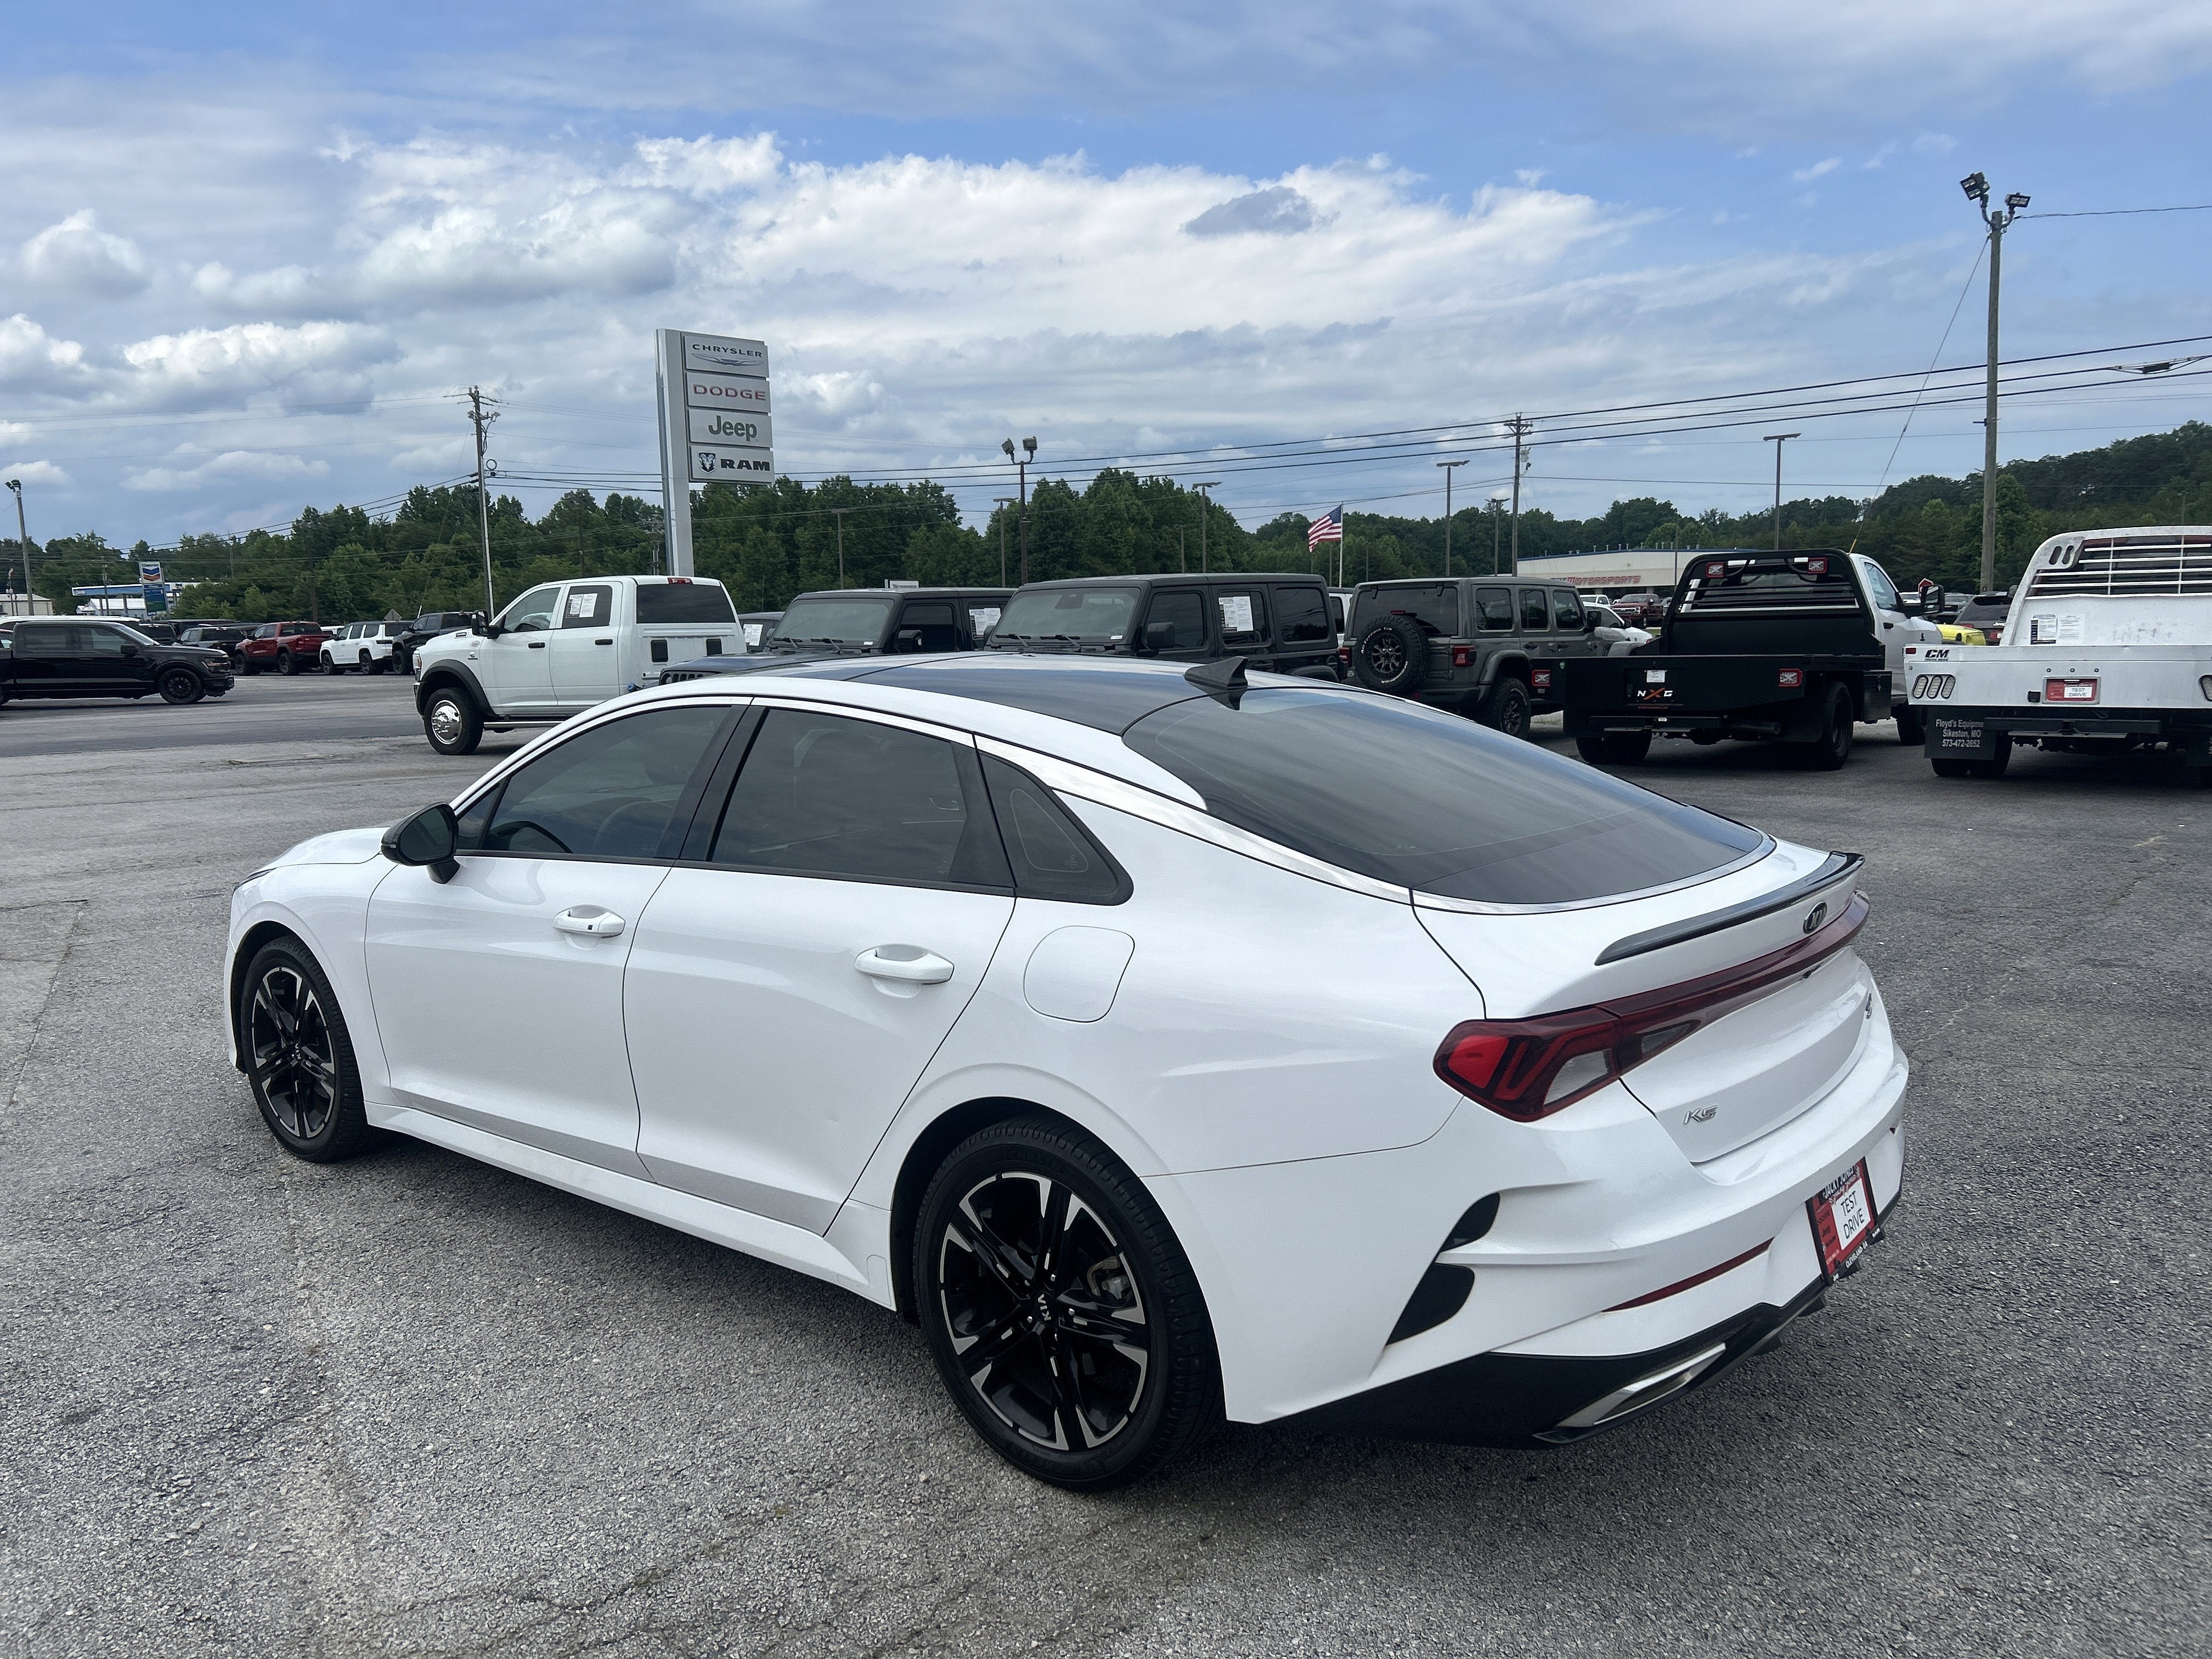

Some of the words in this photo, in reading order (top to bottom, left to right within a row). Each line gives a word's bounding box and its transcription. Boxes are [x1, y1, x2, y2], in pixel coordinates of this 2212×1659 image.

[692, 344, 763, 357] CHRYSLER
[693, 384, 766, 401] DODGE
[708, 415, 758, 442] Jeep
[720, 459, 770, 471] RAM
[1925, 650, 1950, 658] CM
[1637, 687, 1673, 700] NXG
[1936, 719, 1957, 729] Floyd's
[1958, 719, 1984, 729] Equipme
[1943, 729, 1970, 738] Sikeston,
[1971, 729, 1982, 738] MO
[1683, 1105, 1718, 1125] K5
[1841, 1190, 1857, 1216] TEST
[1843, 1208, 1864, 1239] DRIVE
[1037, 1293, 1052, 1322] KIA
